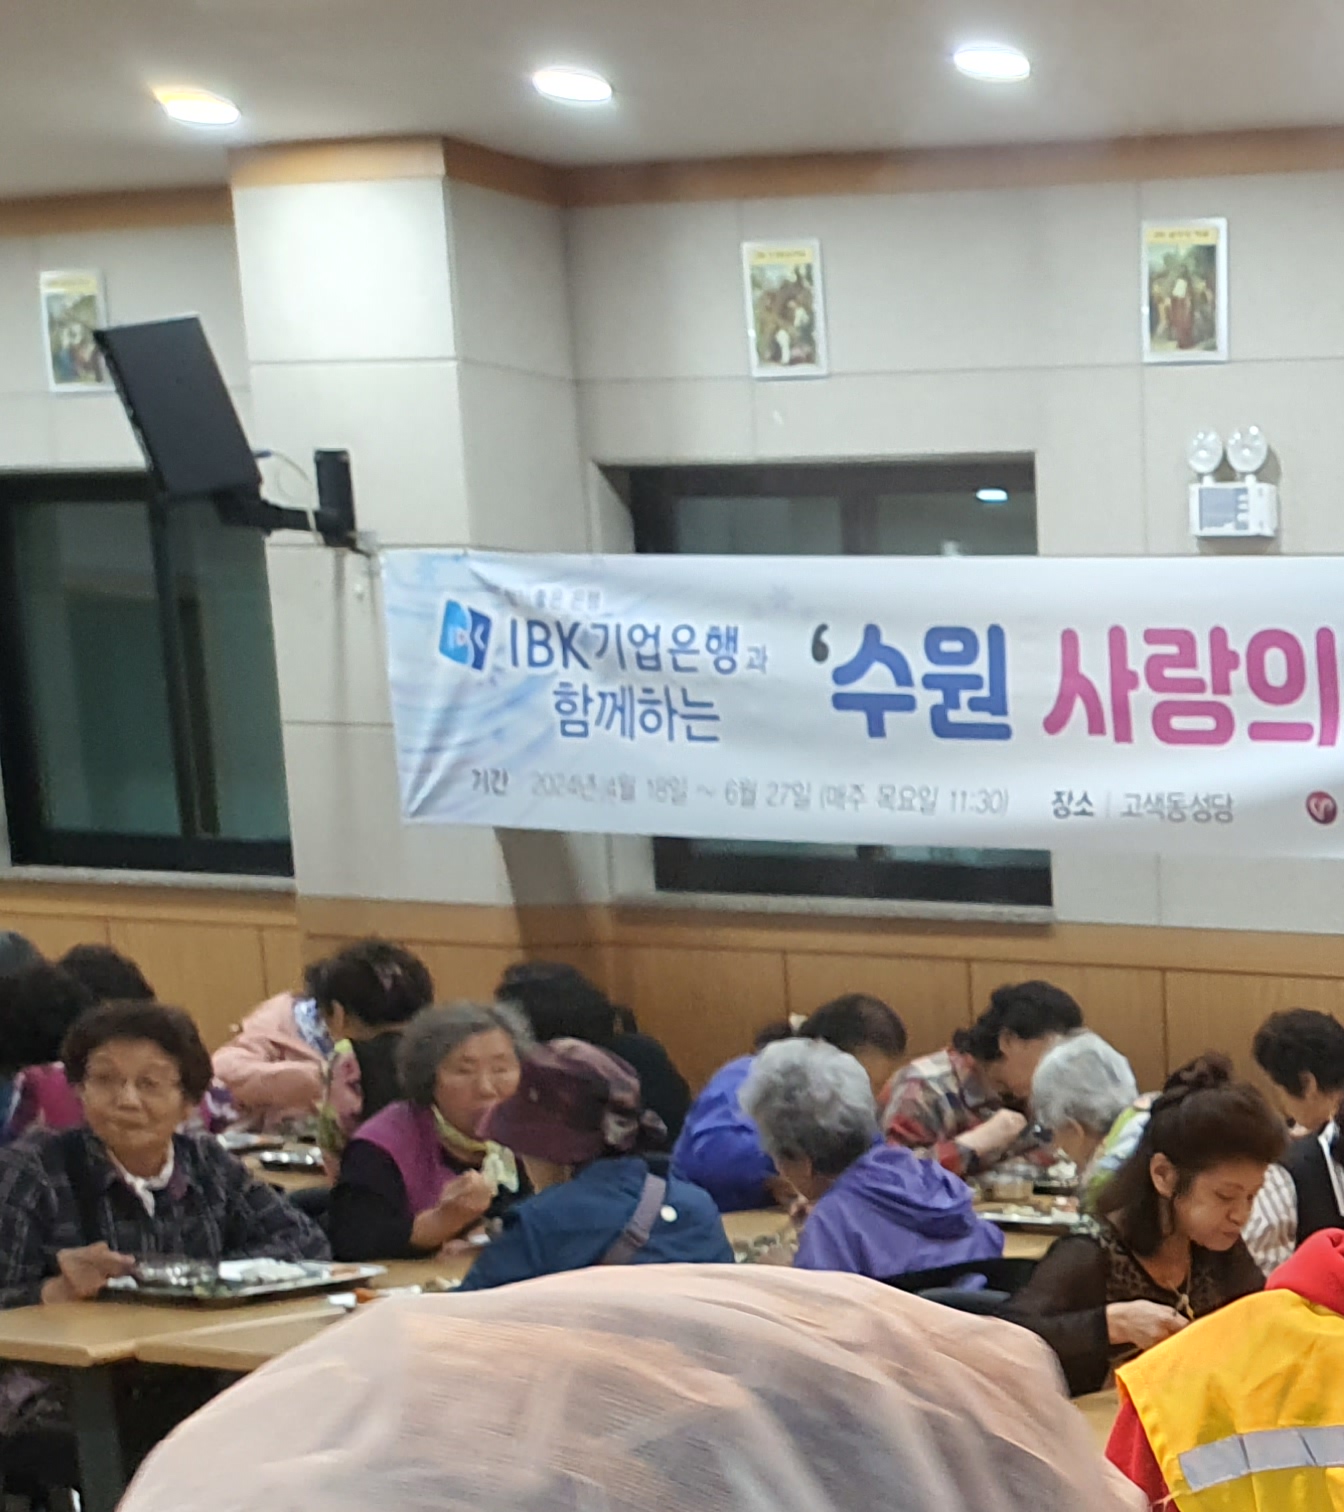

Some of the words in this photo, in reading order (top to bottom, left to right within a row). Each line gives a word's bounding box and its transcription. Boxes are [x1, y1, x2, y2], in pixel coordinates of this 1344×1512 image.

[508, 616, 769, 676] IBK기업은행과
[1042, 624, 1337, 748] 사랑의
[552, 680, 721, 744] 함께하는
[471, 767, 509, 798] 기간
[725, 777, 758, 809] 6월
[766, 778, 812, 811] 27일
[877, 783, 938, 816] 목요일
[1051, 789, 1094, 820] 장소
[1121, 790, 1234, 825] 고색동성당
